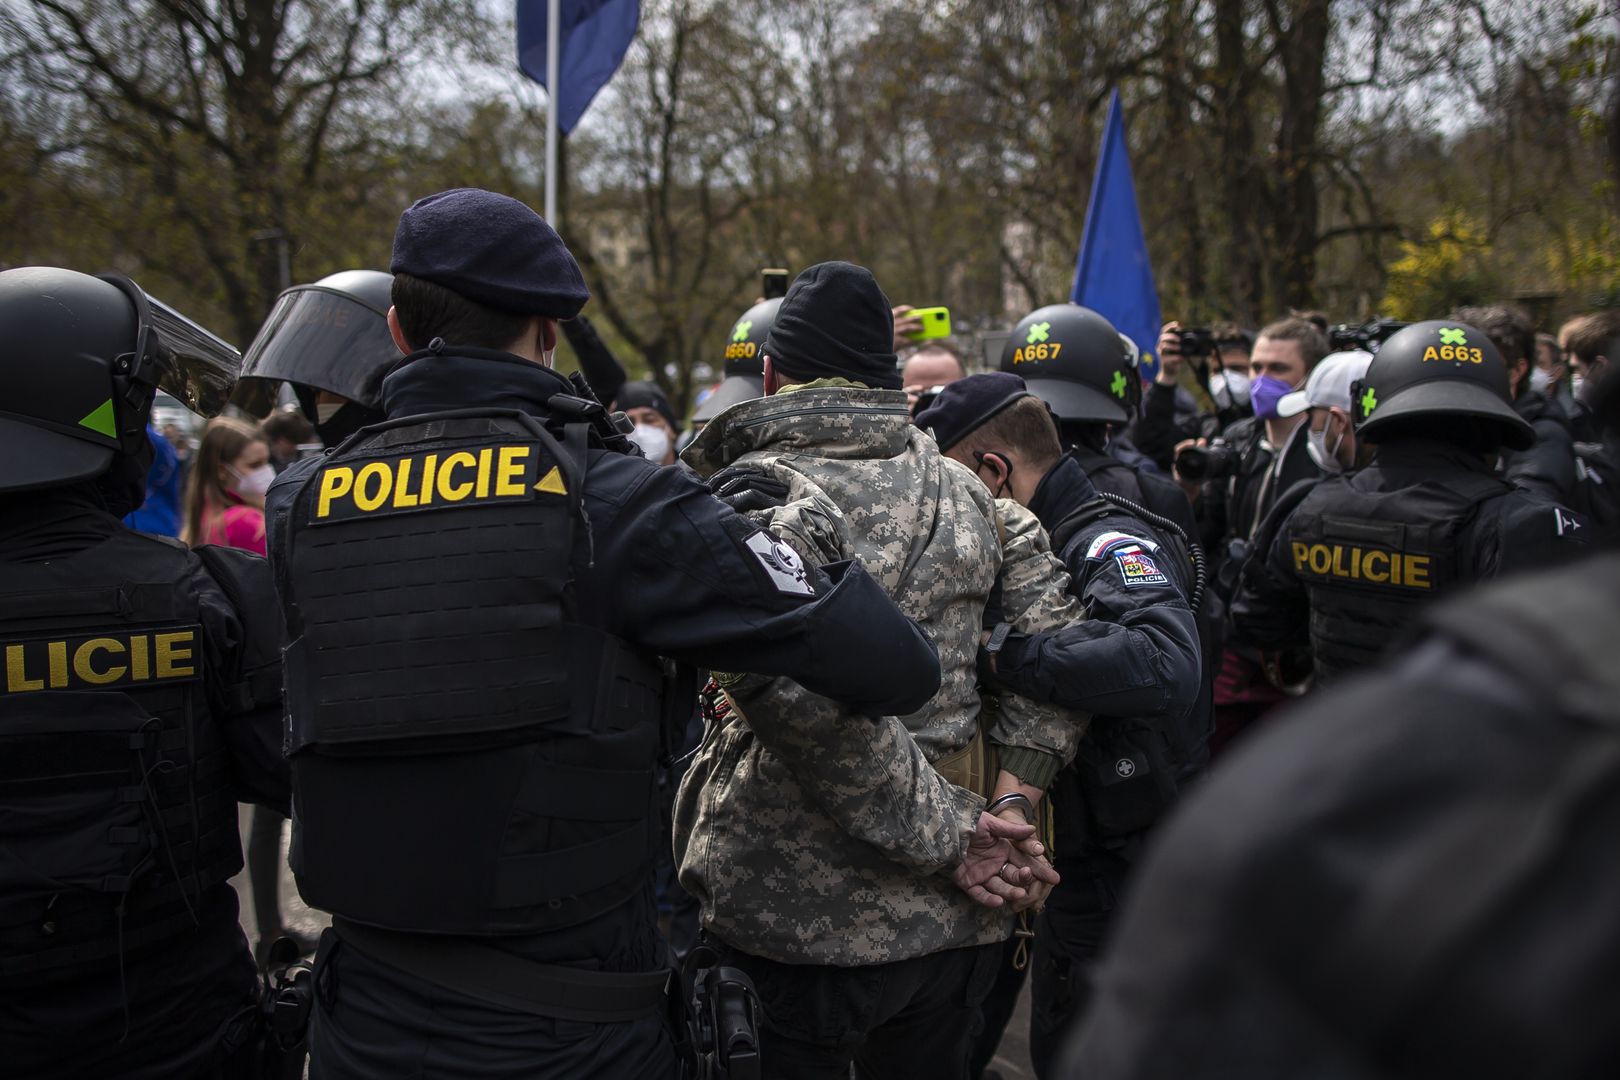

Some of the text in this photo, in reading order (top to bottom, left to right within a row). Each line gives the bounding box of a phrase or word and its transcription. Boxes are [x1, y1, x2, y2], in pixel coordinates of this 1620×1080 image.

[1013, 343, 1062, 364] A667
[1423, 345, 1483, 364] A663
[316, 446, 530, 518] POLICIE
[1292, 541, 1431, 588] POLICIE
[1127, 575, 1164, 583] POLICIE
